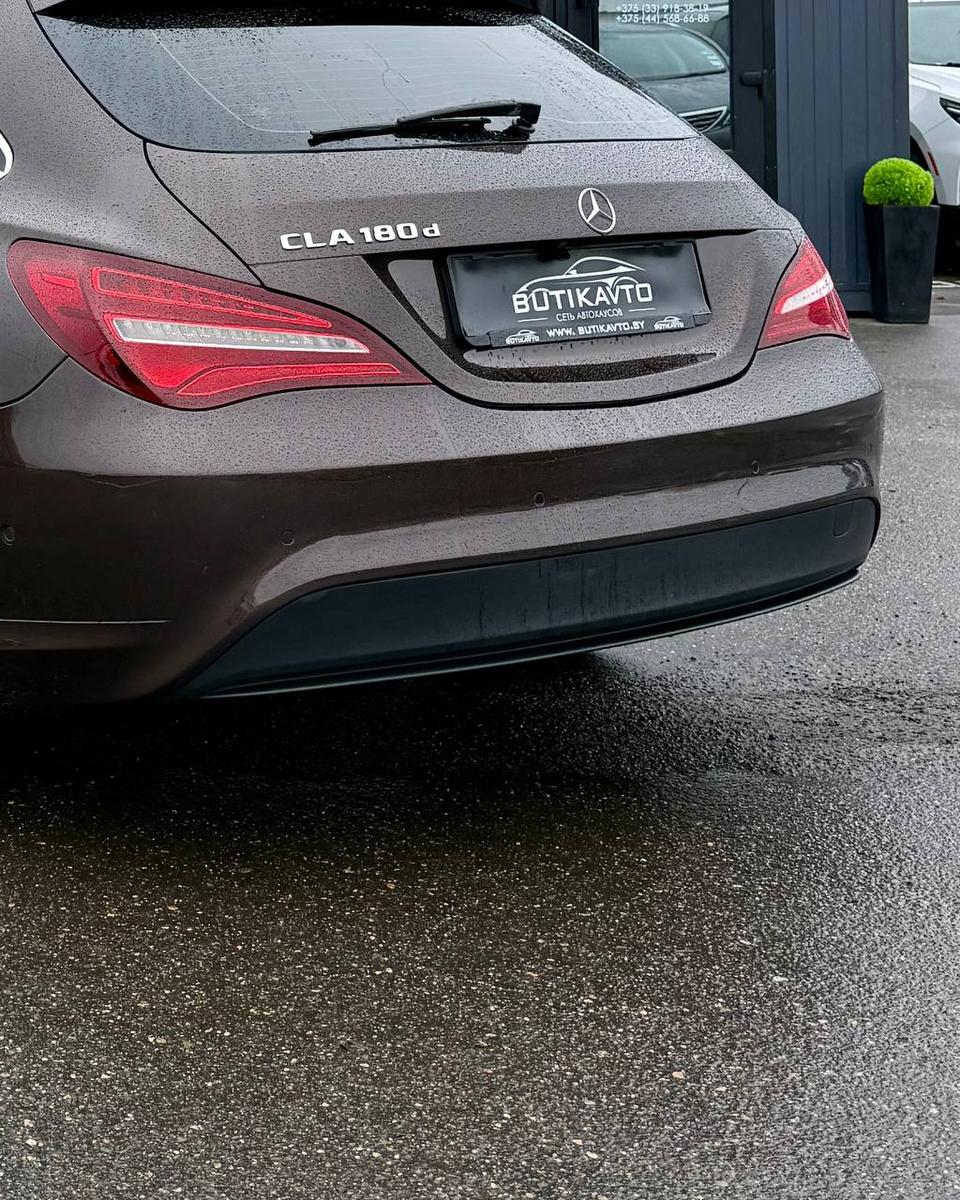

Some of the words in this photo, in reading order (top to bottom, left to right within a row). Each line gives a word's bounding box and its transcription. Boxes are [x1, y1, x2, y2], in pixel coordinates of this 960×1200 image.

[616, 3, 639, 13] +375
[642, 3, 660, 15] (33)
[616, 14, 639, 23] +375
[642, 14, 660, 25] (44)
[663, 14, 710, 23] 568-66-88
[280, 228, 355, 251] CLA
[359, 222, 419, 243] 180
[422, 222, 441, 238] d
[512, 282, 653, 314] BUTIKAVTO
[556, 312, 575, 322] СЕТЬ
[576, 308, 623, 321] АВТОХАУСОВ
[546, 327, 576, 338] WWW.
[577, 320, 645, 335] BUTIKAVTO.BY
